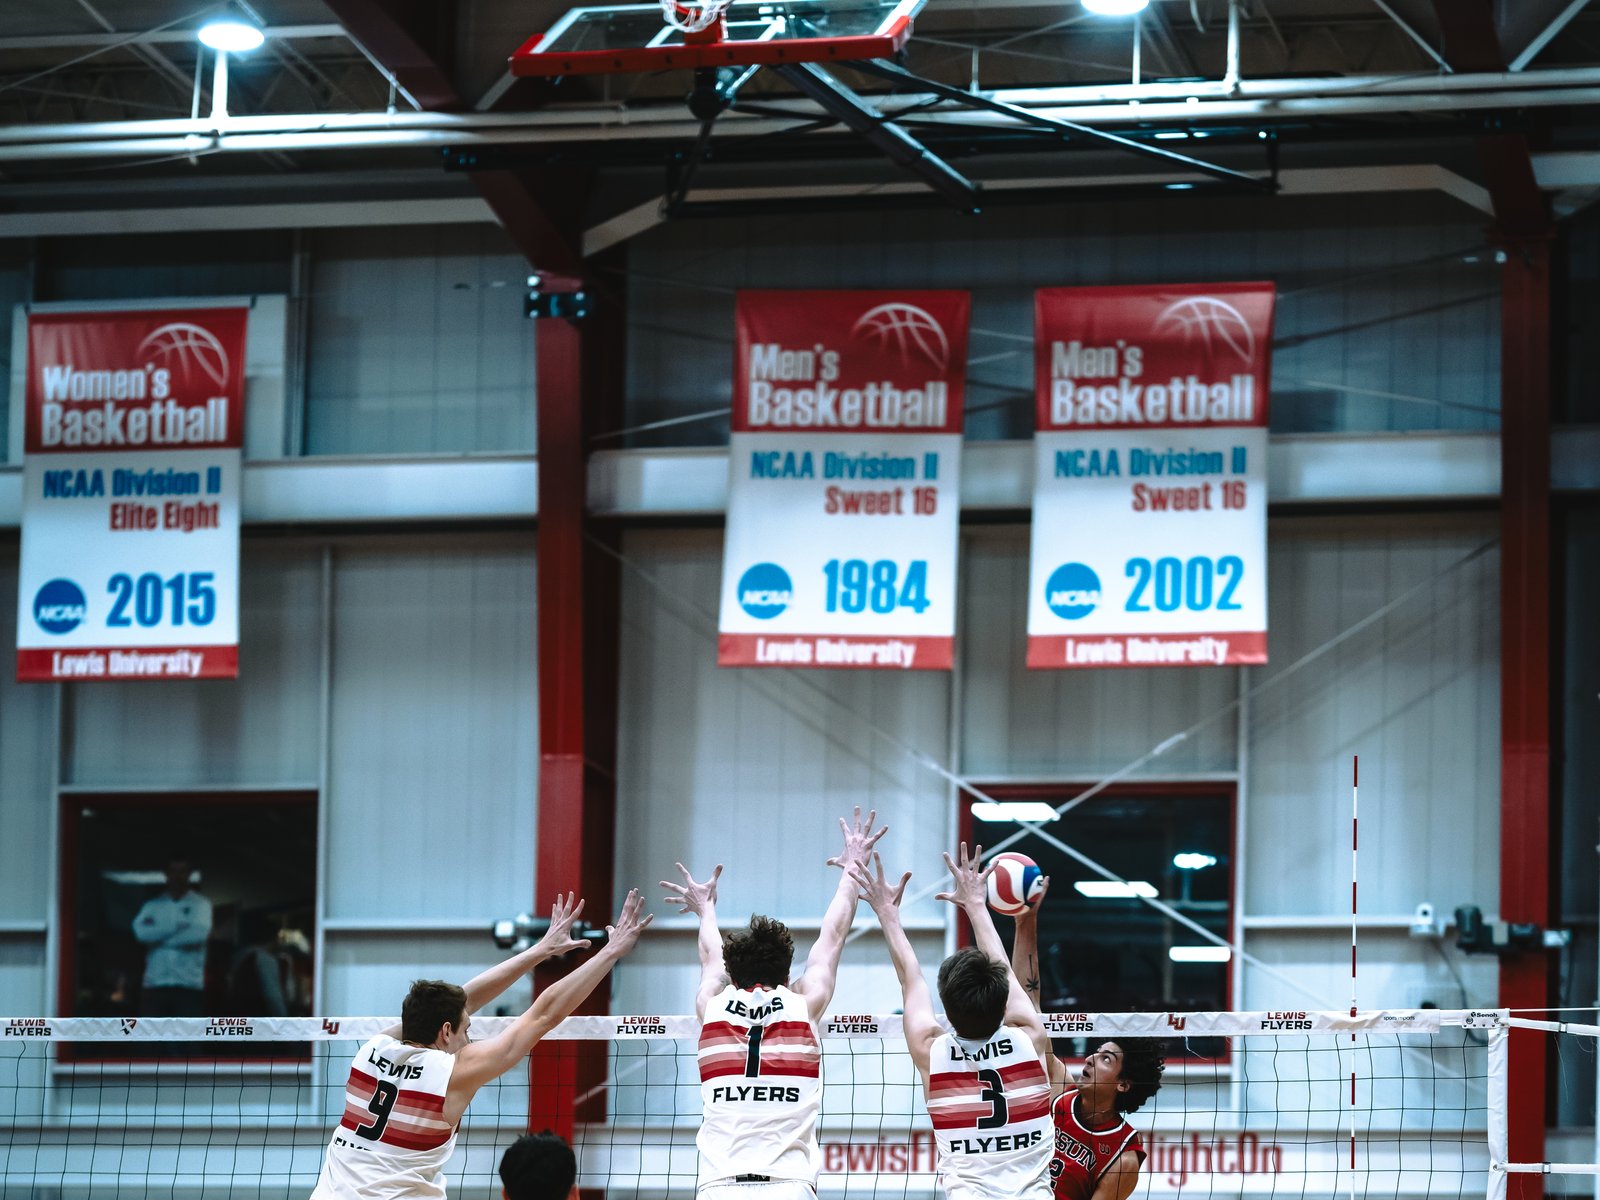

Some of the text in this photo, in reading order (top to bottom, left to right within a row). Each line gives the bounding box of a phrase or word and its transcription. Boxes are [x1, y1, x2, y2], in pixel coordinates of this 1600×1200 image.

[750, 343, 840, 381] Men's
[1051, 341, 1143, 379] Men's
[42, 362, 171, 401] Women's
[748, 381, 947, 427] Basketball
[1050, 375, 1255, 425] Basketball
[41, 397, 228, 447] Basketball
[750, 451, 938, 480] NCAA Division II
[1054, 446, 1247, 478] NCAA Division II
[43, 466, 221, 498] NCAA Division II
[824, 486, 938, 515] Sweet 16
[1132, 481, 1247, 513] Sweet 16
[110, 502, 219, 533] Elite Eight
[742, 590, 791, 606] NCAA
[823, 559, 930, 614] 1984
[1050, 590, 1100, 606] NCAA
[1124, 555, 1244, 612] 2002
[38, 604, 84, 623] NCAA
[105, 572, 216, 627] 2015
[52, 649, 203, 677] Lewis University
[756, 638, 916, 668] Lewis University
[1066, 637, 1229, 665] Lewis University
[210, 1018, 247, 1026] LEWIS
[617, 1025, 666, 1034] FLYERS
[623, 1016, 660, 1024] LEWIS
[828, 1024, 878, 1033] FLYERS
[834, 1015, 872, 1023] LEWIS
[1049, 1014, 1088, 1022] LEWIS
[1260, 1021, 1312, 1030] FLYERS
[1267, 1012, 1306, 1020] LEWIS
[5, 1027, 52, 1036] FLYERS
[205, 1027, 253, 1036] FLYERS
[367, 1047, 424, 1080] LEWIS
[745, 1024, 764, 1078] 1
[712, 1086, 800, 1103] FLYERS
[977, 1068, 1009, 1130] 3
[354, 1079, 399, 1142] 9
[949, 1129, 1042, 1154] FLYERS
[1145, 1131, 1283, 1187] lightOn
